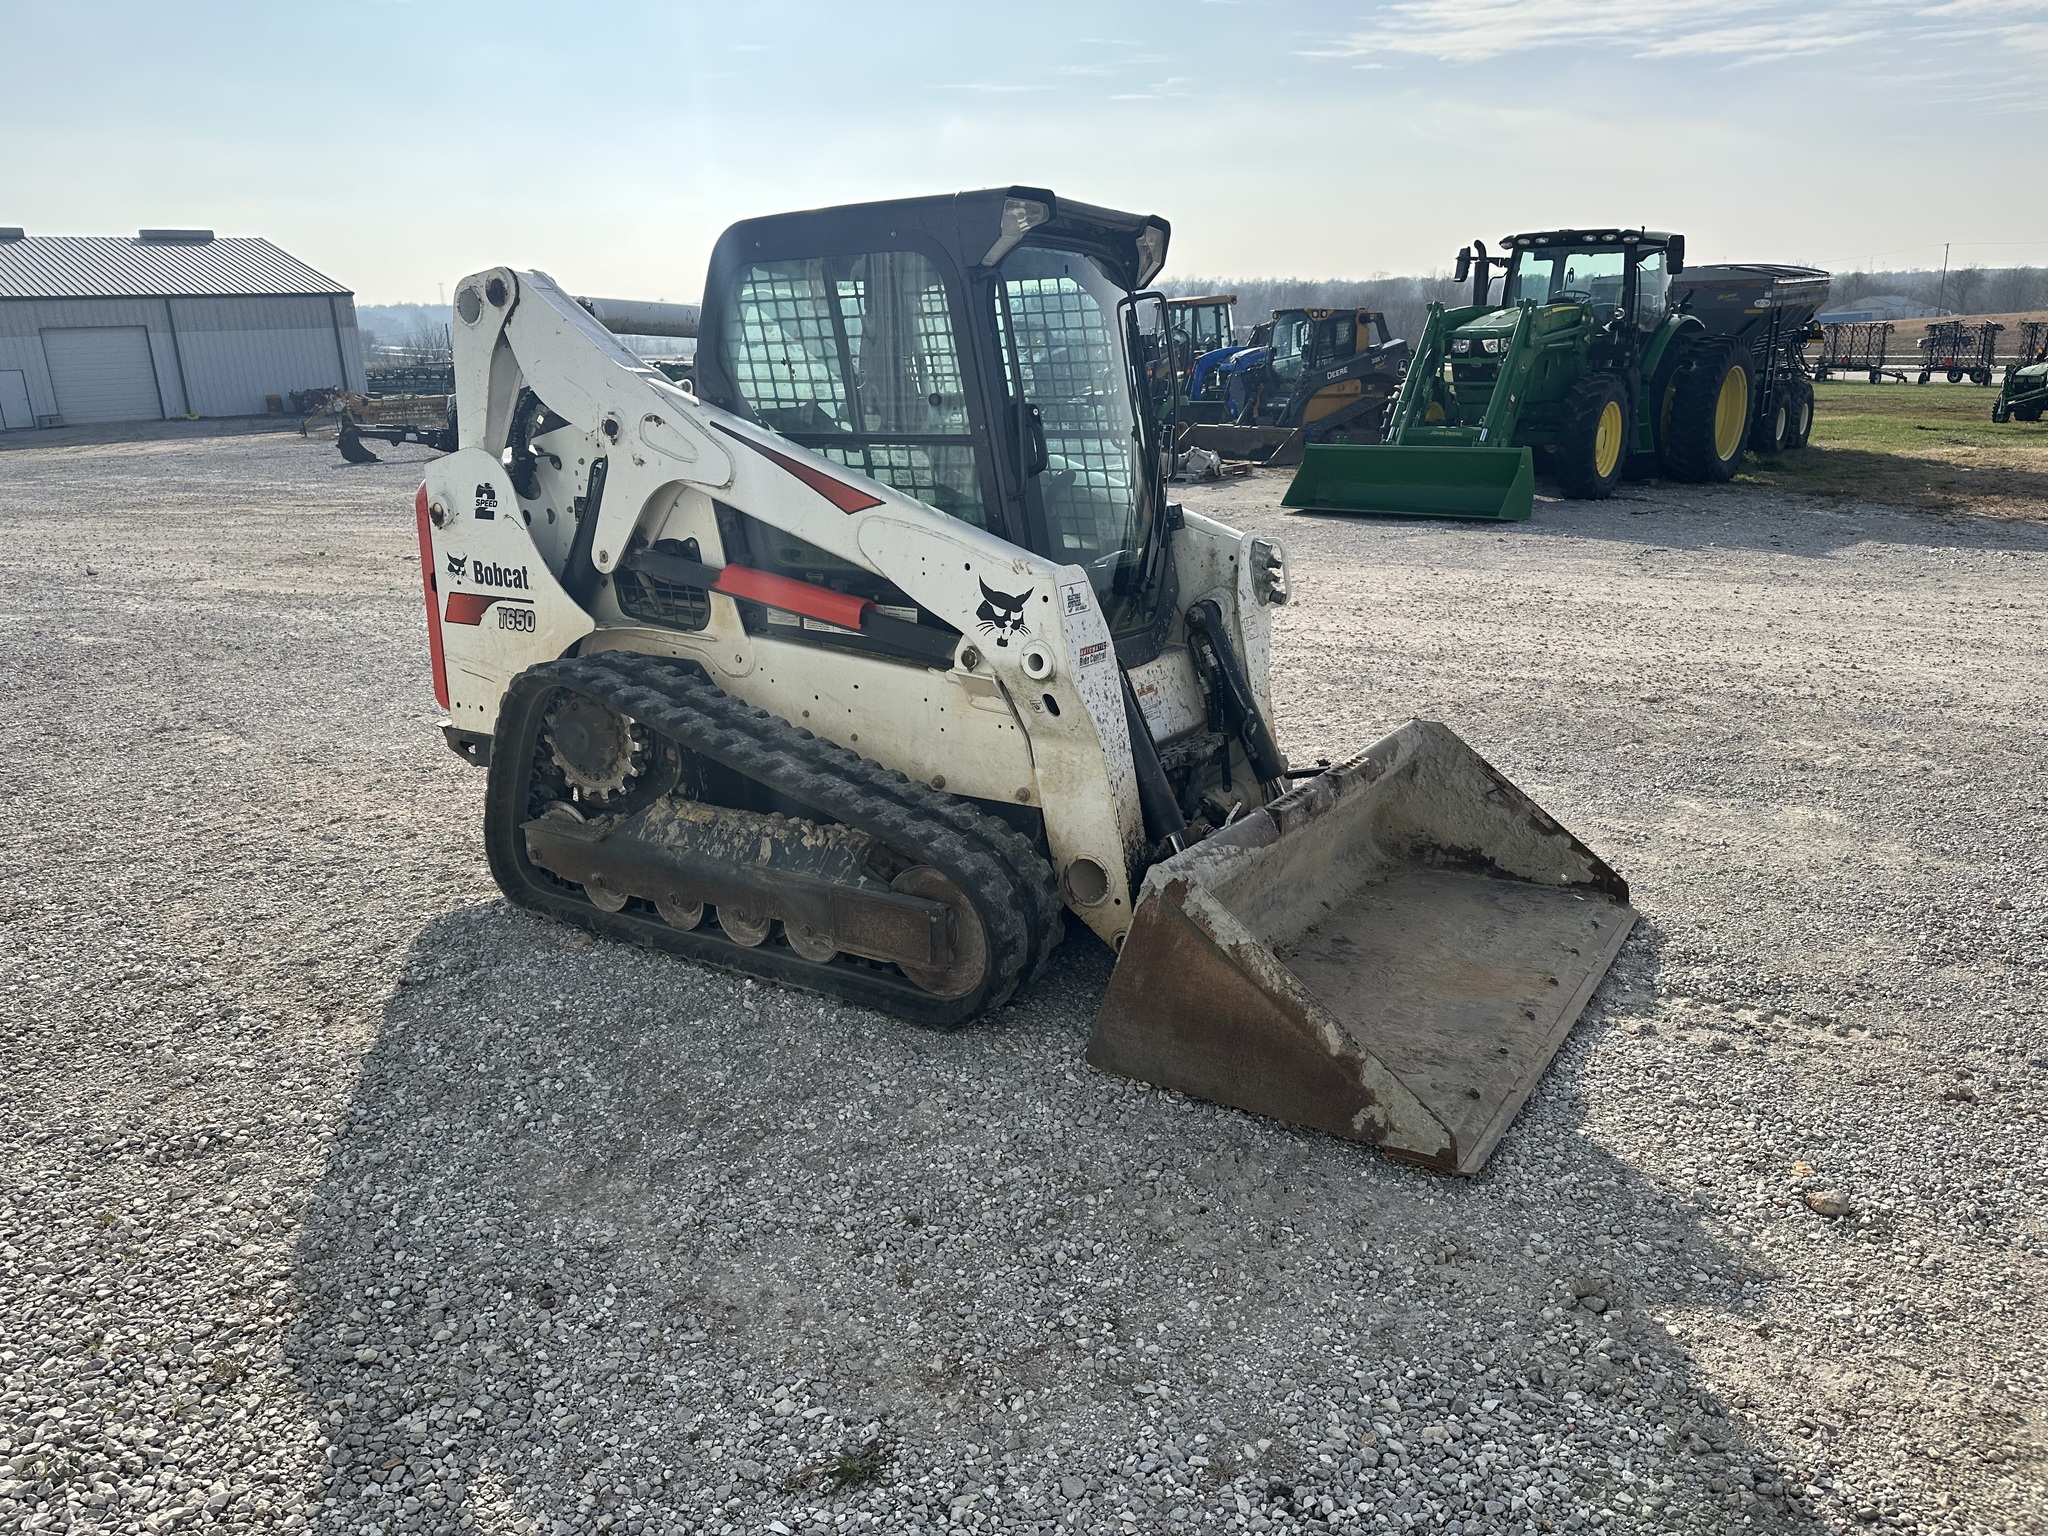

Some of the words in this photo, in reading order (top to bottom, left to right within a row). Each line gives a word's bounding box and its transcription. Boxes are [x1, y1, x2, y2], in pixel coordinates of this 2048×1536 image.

[1326, 366, 1348, 380] DEERE
[475, 498, 498, 508] SPEED
[473, 560, 529, 590] Bobcat
[497, 606, 536, 632] T650
[1089, 650, 1107, 663] Control
